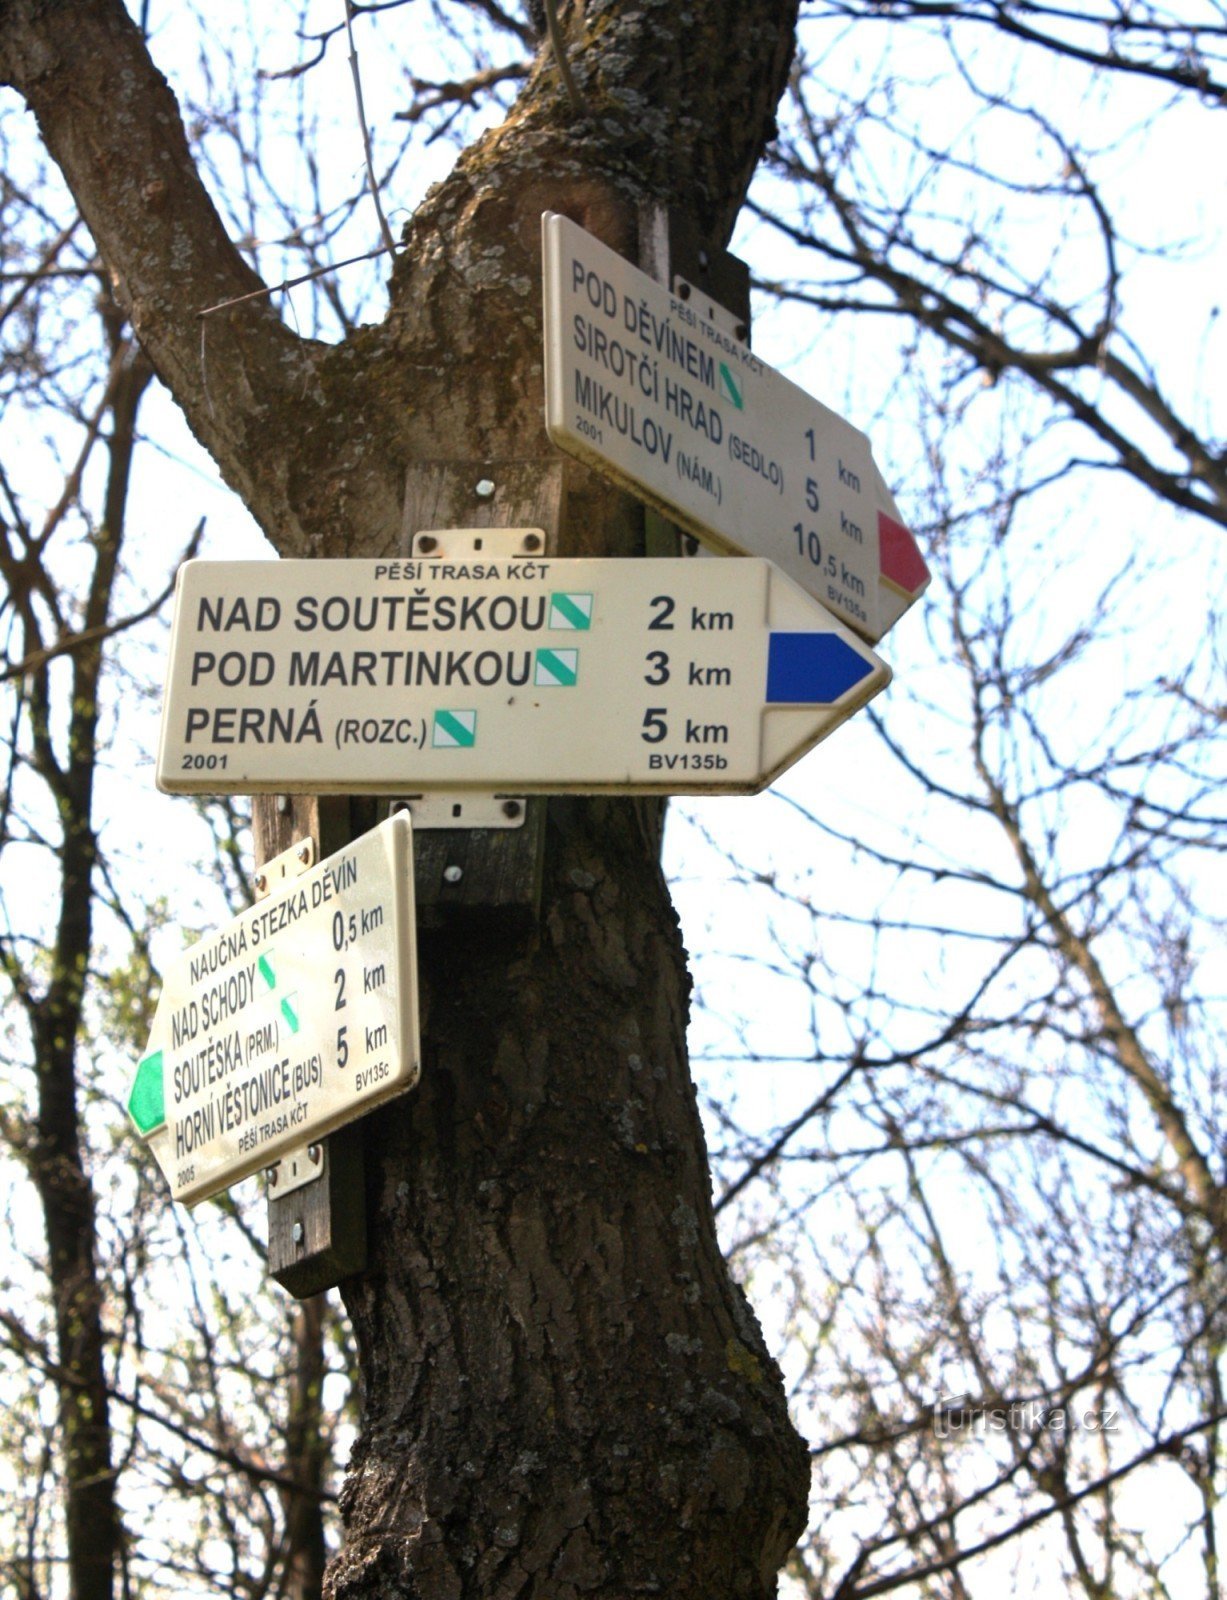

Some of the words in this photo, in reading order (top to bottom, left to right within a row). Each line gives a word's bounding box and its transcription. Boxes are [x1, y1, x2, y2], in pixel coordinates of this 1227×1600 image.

[572, 260, 616, 317] POD
[624, 295, 715, 389] DĚVÍNEM
[670, 298, 697, 327] PĚŠÍ
[699, 320, 739, 361] TRASA
[740, 348, 765, 377] KČT
[574, 315, 659, 402] SIROTČÍ
[665, 377, 723, 445] HRAD
[729, 432, 784, 495] (SEDLO)
[575, 369, 672, 464] MIKULOV
[676, 452, 723, 505] (NÁM.)
[576, 415, 603, 445] 2001
[804, 429, 816, 461] 1
[838, 459, 861, 493] km
[805, 480, 820, 512] 5
[840, 511, 863, 544] km
[374, 563, 422, 580] PĚŠÍ
[429, 566, 500, 579] TRASA
[508, 564, 551, 579] KČT
[793, 523, 837, 578] 10,5
[842, 562, 865, 597] km
[197, 597, 281, 632] NAD
[294, 588, 546, 632] SOUTĚSKOU
[648, 596, 675, 631] 2
[691, 607, 734, 630] km
[827, 585, 868, 623] BV135a
[191, 651, 275, 686] POD
[288, 651, 532, 686] MARTINKOU
[644, 651, 671, 686] 3
[689, 662, 731, 686] km
[184, 699, 323, 743] PERNÁ
[335, 719, 427, 749] (ROZC.)
[641, 708, 668, 743] 5
[686, 720, 728, 742] km
[181, 754, 228, 769] 2001
[649, 754, 728, 769] BV135b
[190, 923, 247, 986] NAUČNÁ
[252, 892, 308, 946] STEZKA
[312, 856, 358, 909] DĚVÍN
[333, 911, 357, 952] 0,5
[361, 904, 383, 936] km
[172, 1003, 199, 1050] NAD
[202, 964, 255, 1032] SCHODY
[334, 968, 346, 1011] 2
[363, 963, 385, 994] km
[173, 1030, 243, 1103] SOUTĚSKA
[245, 1021, 279, 1067] (PRM.)
[337, 1026, 348, 1068] 5
[366, 1023, 388, 1055] km
[356, 1064, 390, 1092] BV135c
[175, 1096, 215, 1160] HORNÍ
[216, 1058, 290, 1140] VĚSTONICE
[292, 1053, 322, 1102] (BUS)
[238, 1128, 258, 1154] PĚŠÍ
[259, 1112, 288, 1143] TRASA
[290, 1102, 309, 1130] KČT
[177, 1166, 195, 1188] 2005
